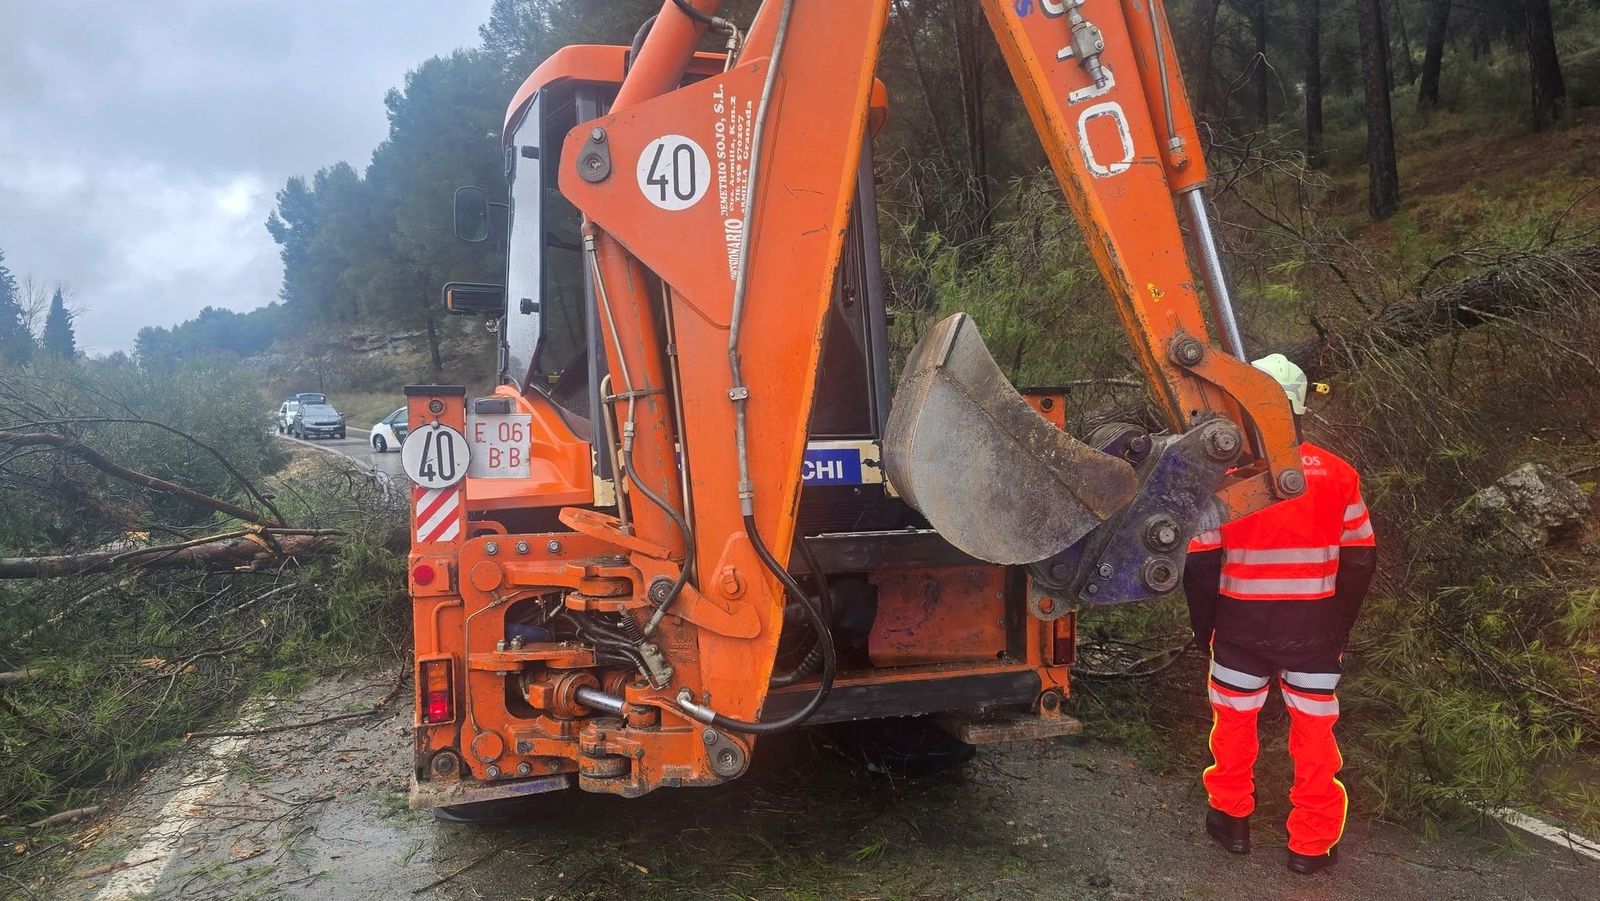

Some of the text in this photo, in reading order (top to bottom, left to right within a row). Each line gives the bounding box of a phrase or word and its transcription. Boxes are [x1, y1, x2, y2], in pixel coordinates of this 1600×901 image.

[646, 143, 696, 202] 40
[713, 83, 729, 216] DEMETRIO SOJO, S.L.
[740, 100, 753, 214] ARMILLA Granada
[418, 430, 456, 482] 40
[475, 422, 487, 443] E
[801, 460, 844, 480] CHI
